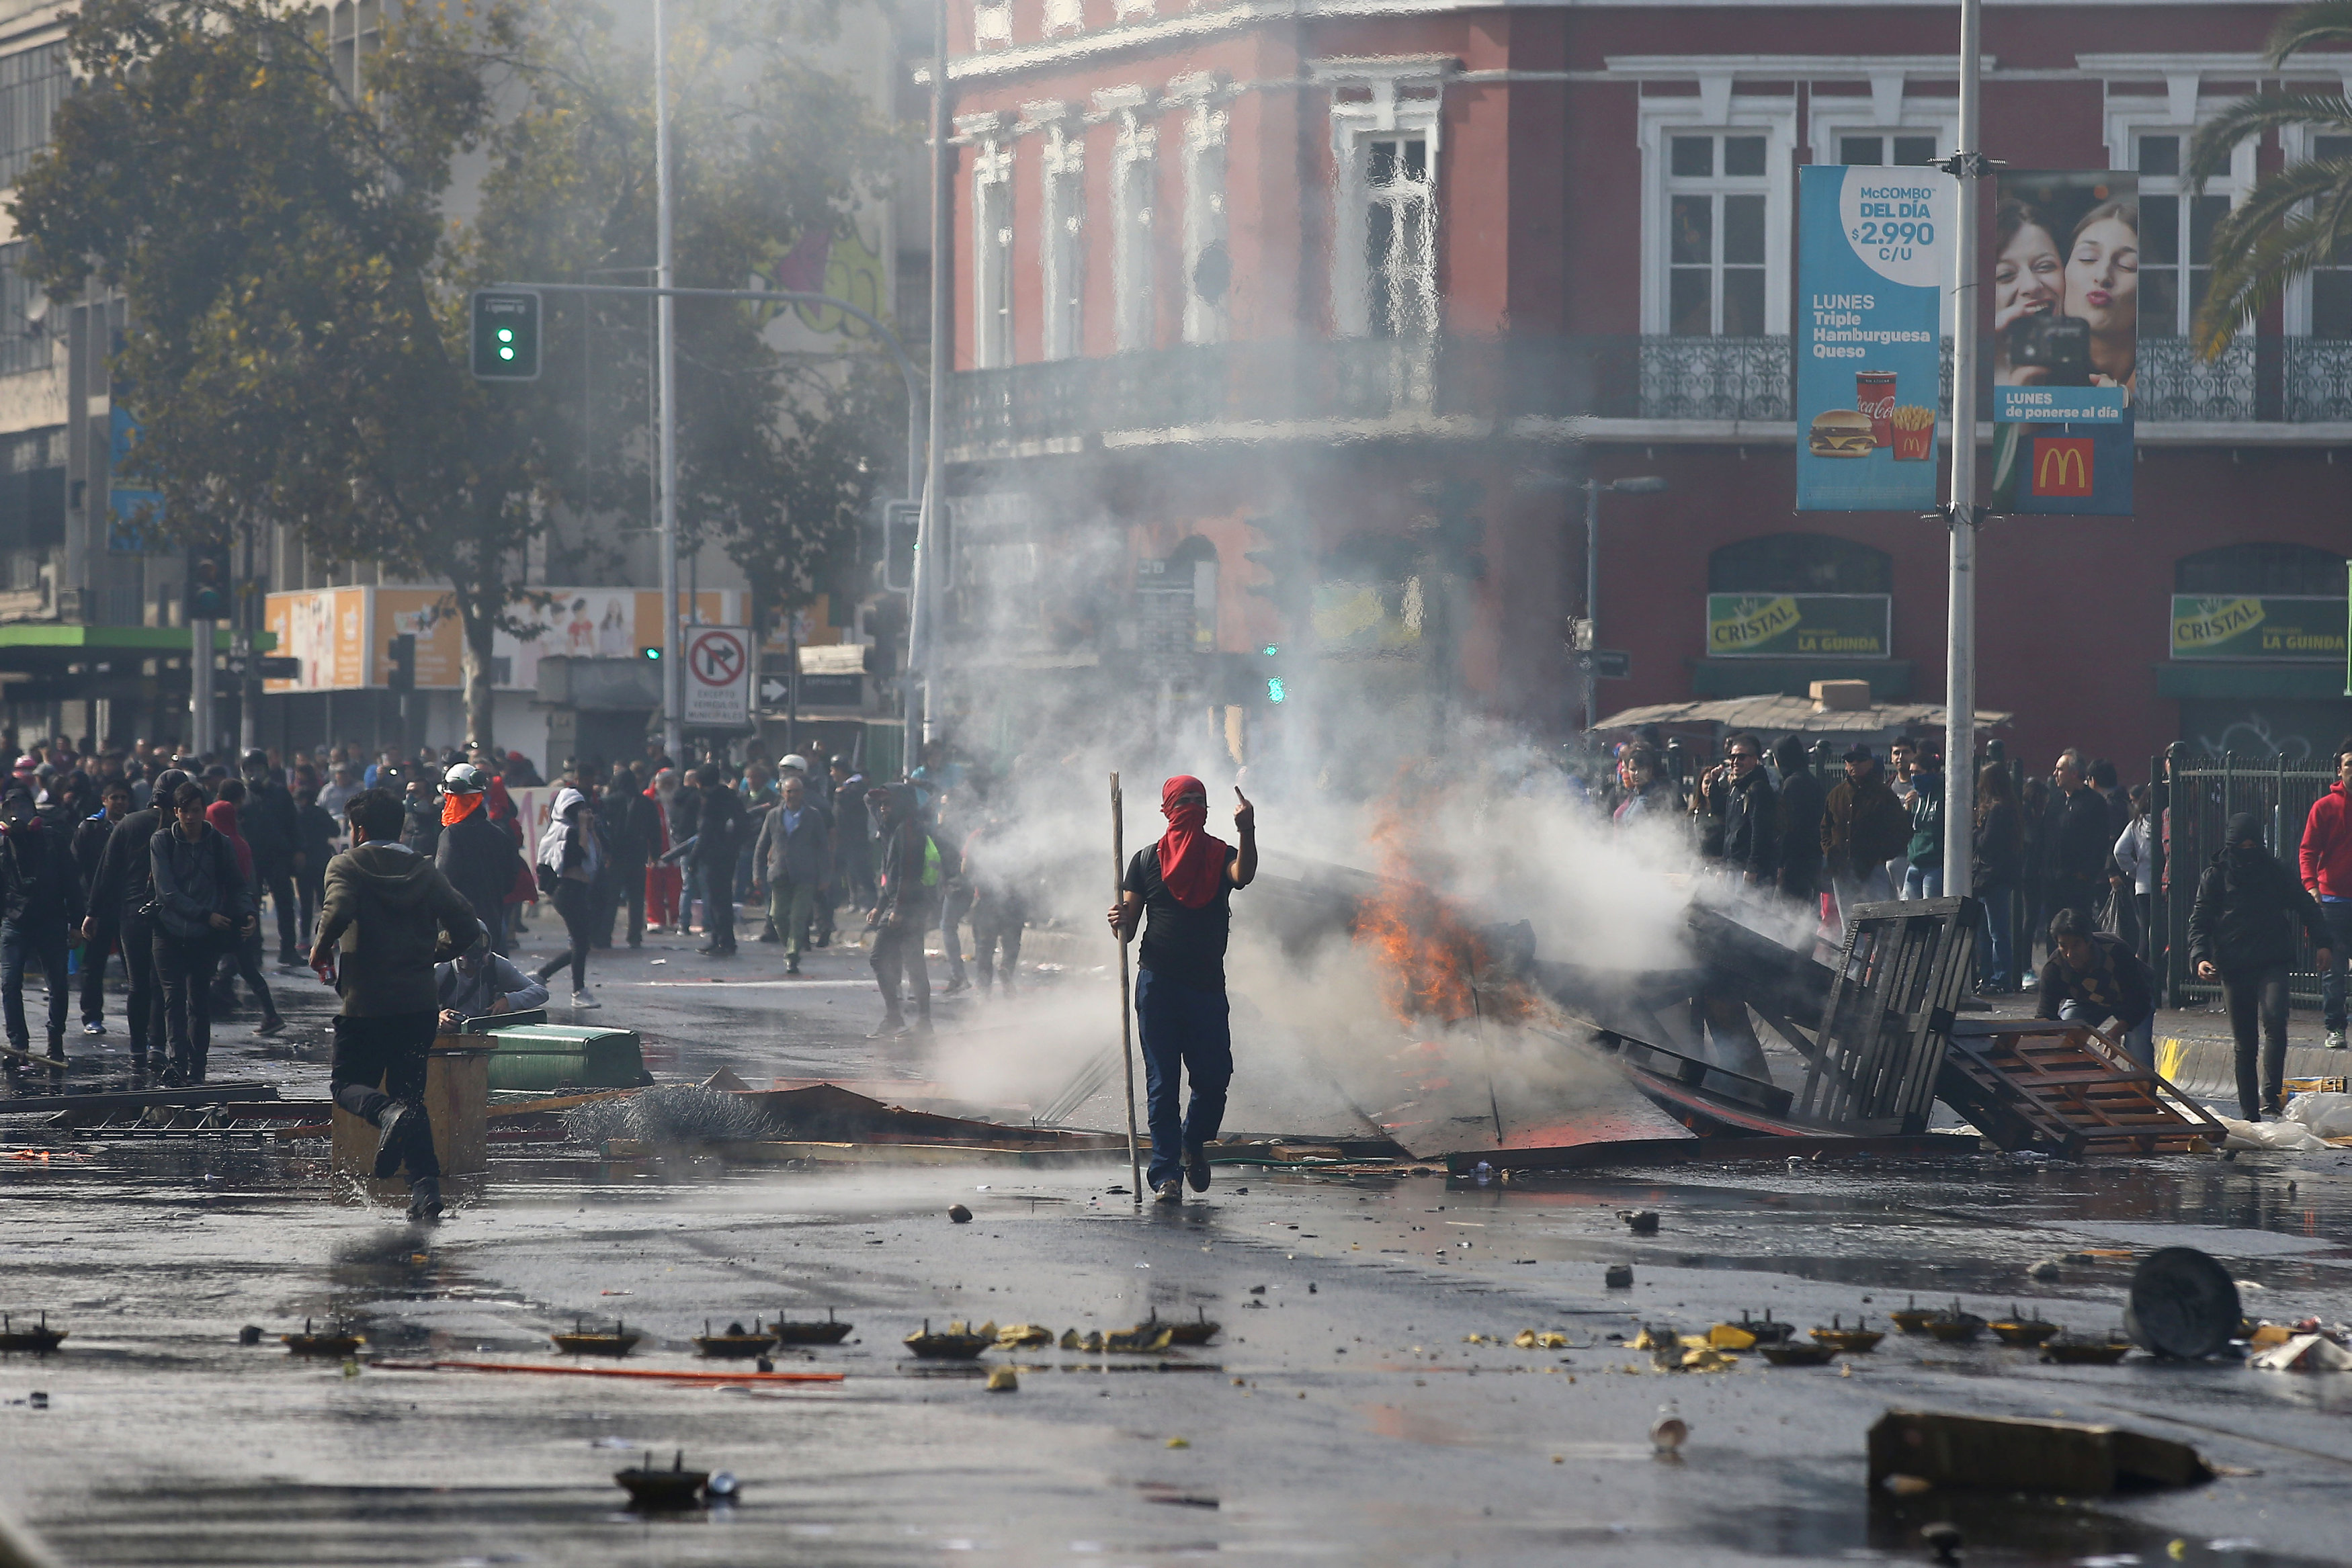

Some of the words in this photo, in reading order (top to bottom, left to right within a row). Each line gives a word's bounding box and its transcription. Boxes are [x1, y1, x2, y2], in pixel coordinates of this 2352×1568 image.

[1860, 203, 1896, 218] DEL
[1899, 200, 1931, 218] DÍA
[1879, 247, 1912, 262] C/U
[1813, 294, 1875, 310] LUNES
[1813, 310, 1861, 328] Triple
[1813, 327, 1931, 345] Hamburguesa
[1813, 343, 1865, 359] Queso
[2006, 393, 2053, 404] LUNES
[2005, 406, 2023, 417] de
[2025, 408, 2079, 420] ponerse
[2082, 406, 2095, 418] al
[2097, 406, 2119, 418] día
[1715, 607, 1794, 643] CRISTAL
[2177, 603, 2258, 640] CRISTAL
[1798, 637, 1816, 650] LA
[1821, 637, 1880, 651] GUINDA
[2263, 635, 2281, 650] LA
[2286, 635, 2345, 650] GUINDA
